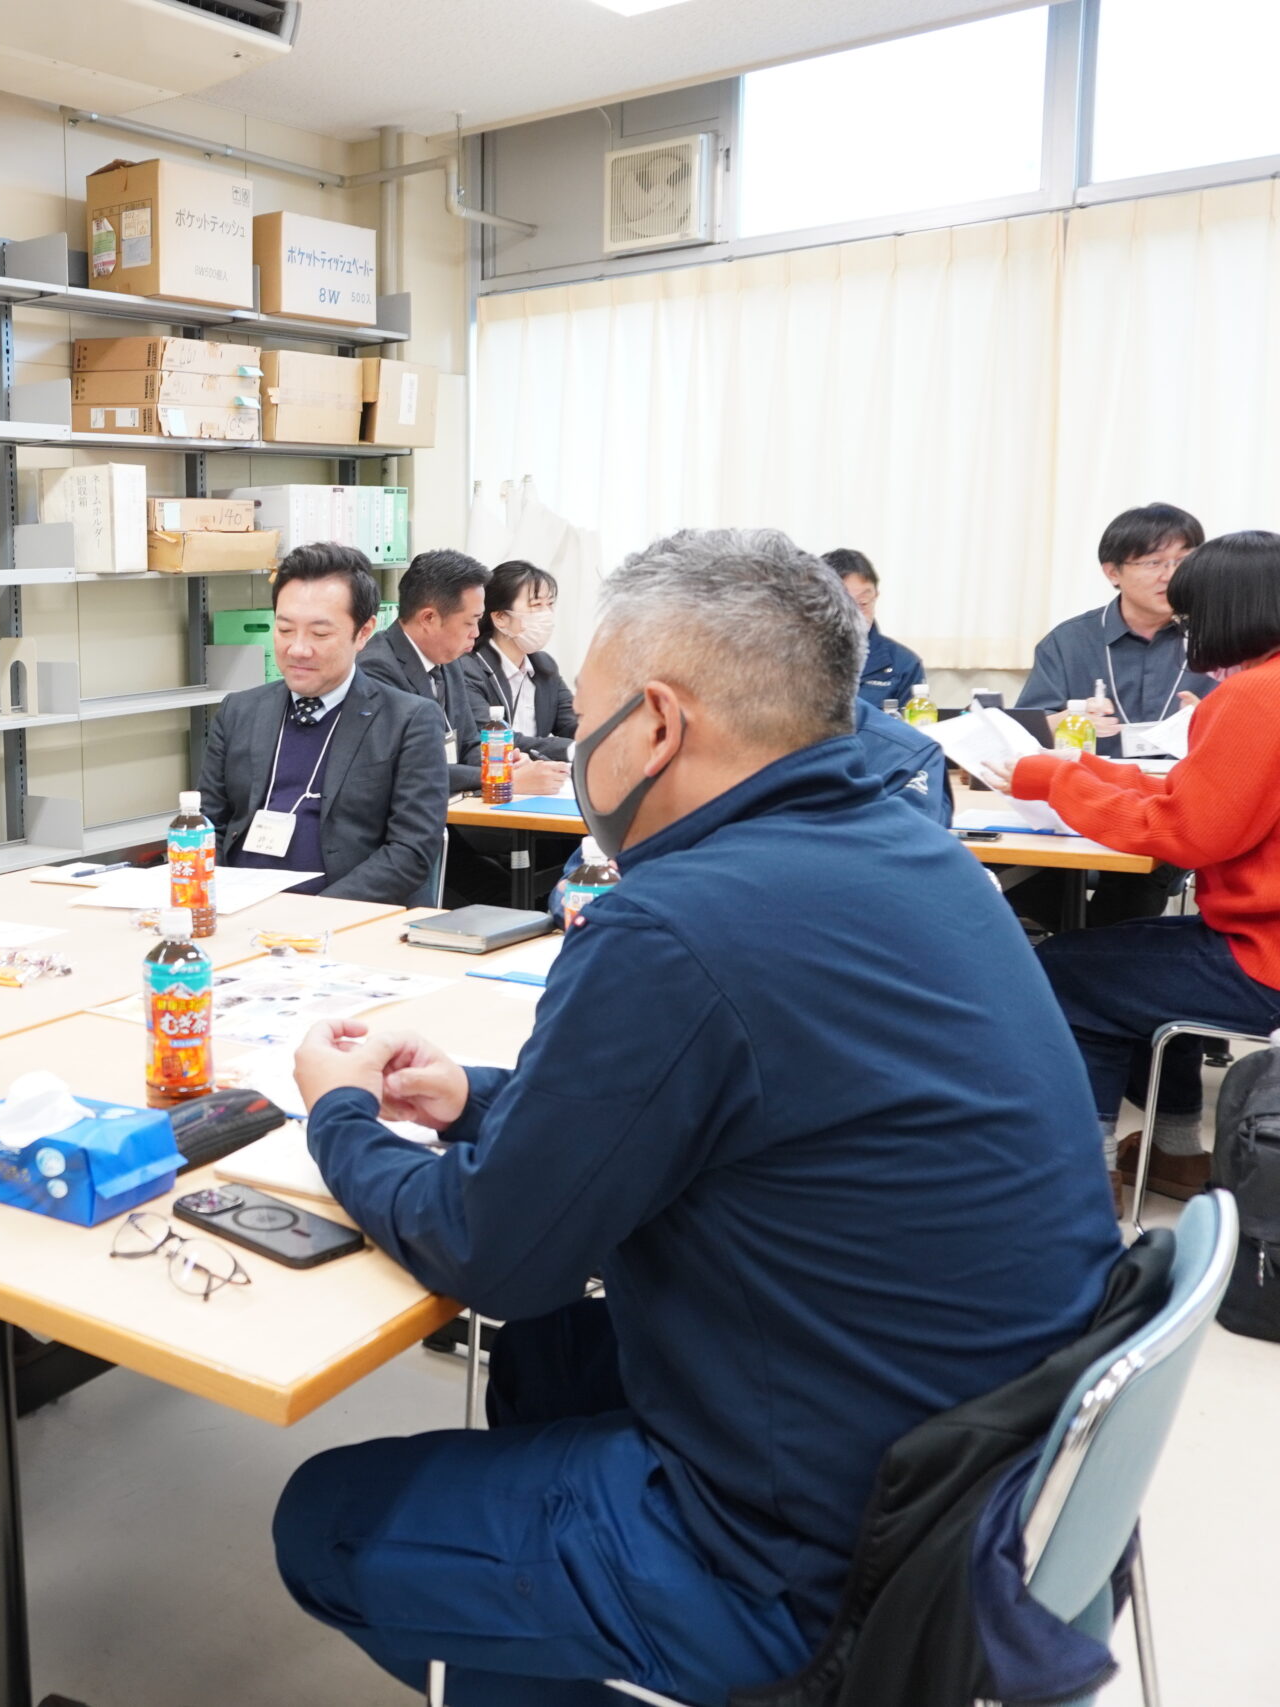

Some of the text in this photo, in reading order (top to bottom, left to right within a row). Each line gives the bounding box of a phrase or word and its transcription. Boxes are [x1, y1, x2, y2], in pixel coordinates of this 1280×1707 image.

[175, 208, 247, 238] ポケットティッシュ
[287, 246, 374, 278] ポケットティッシュペーパー
[319, 287, 341, 305] 8W
[160, 1010, 209, 1035] むぎ茶
